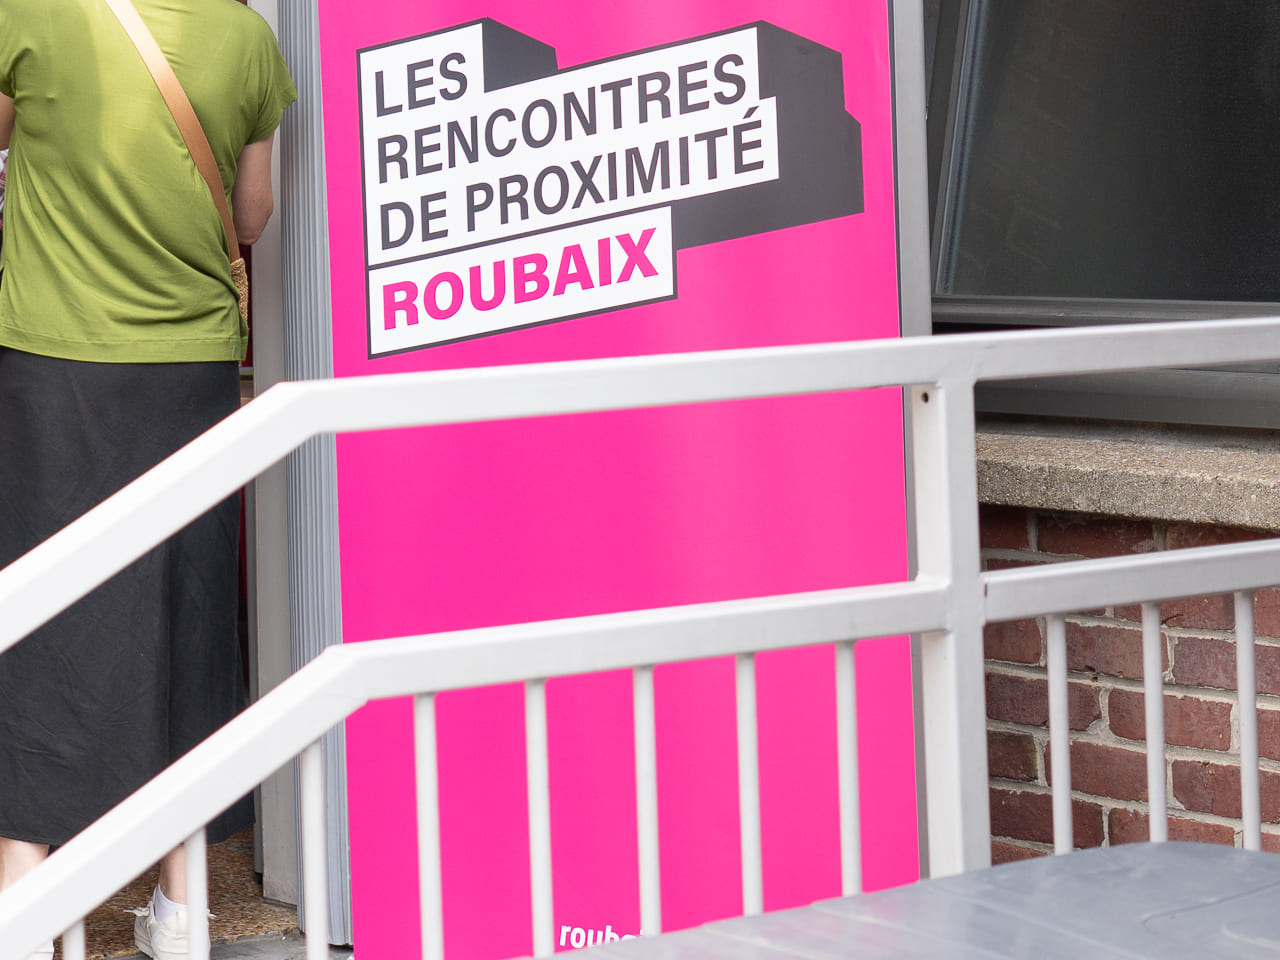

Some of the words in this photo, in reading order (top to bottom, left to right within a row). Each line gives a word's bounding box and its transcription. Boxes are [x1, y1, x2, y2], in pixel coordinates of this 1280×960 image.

[374, 51, 468, 117] LES
[378, 53, 747, 184] RENCONTRES
[380, 190, 449, 251] DE
[466, 106, 765, 232] PROXIMITÉ
[383, 226, 659, 331] ROUBAIX
